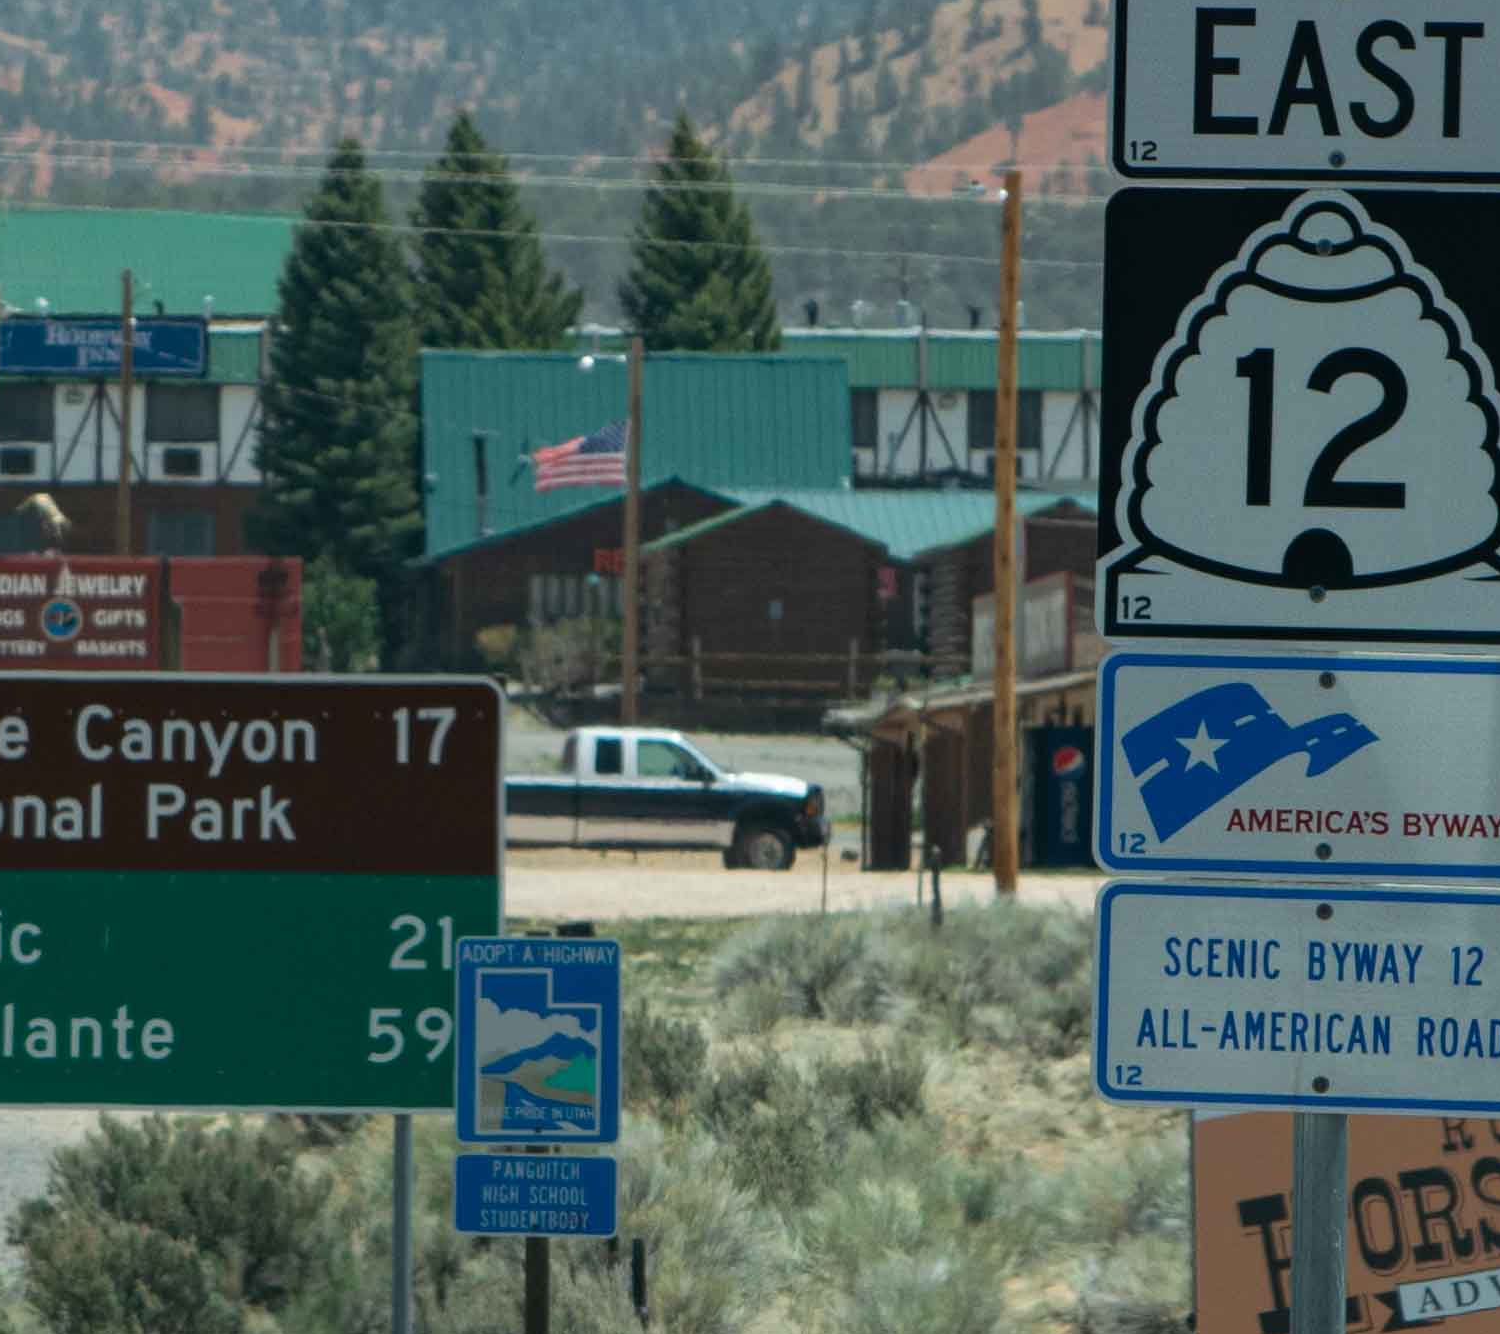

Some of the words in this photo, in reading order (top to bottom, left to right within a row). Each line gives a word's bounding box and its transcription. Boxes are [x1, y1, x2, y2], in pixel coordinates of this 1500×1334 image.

[1193, 7, 1485, 139] EAST
[1129, 140, 1158, 162] 12
[1235, 346, 1409, 509] 12
[93, 609, 147, 627] GIFTS
[1120, 596, 1152, 620] 12
[76, 640, 147, 657] BASKETS
[75, 703, 318, 777] Canyon
[391, 707, 457, 764] 17
[147, 782, 297, 842] Park
[1226, 808, 1390, 835] AMERICA'S
[1118, 833, 1147, 855] 12
[388, 915, 455, 970] 21
[1164, 937, 1281, 981] SCENIC
[1308, 942, 1424, 985] BYWAY
[1451, 946, 1483, 987] 12
[366, 1006, 455, 1064] 59
[1137, 1008, 1391, 1055] ALL-AMERICAN
[1115, 1064, 1143, 1086] 12
[492, 1160, 580, 1180] PANGUITCH
[481, 1185, 519, 1204] HIGH
[529, 1185, 588, 1206] SCHOOL
